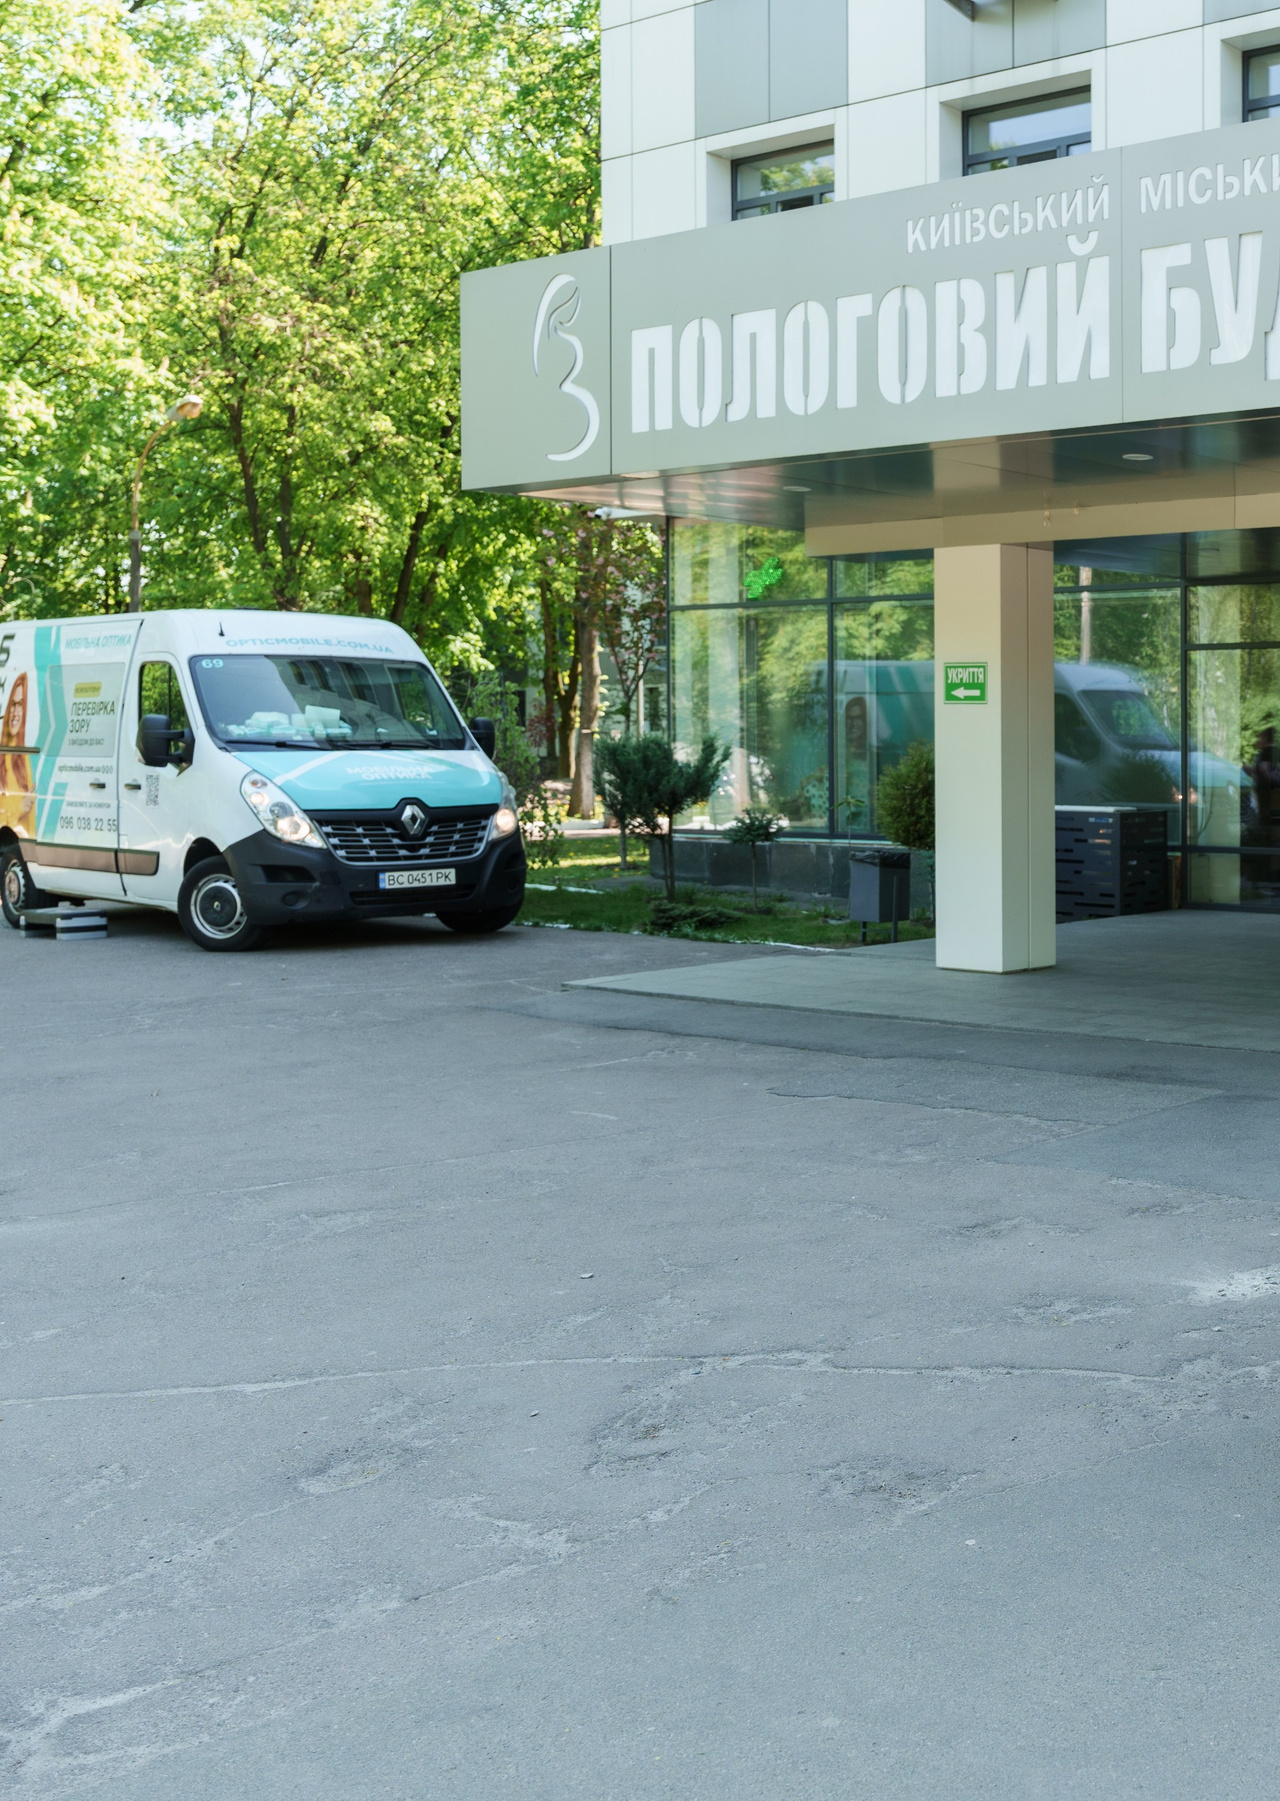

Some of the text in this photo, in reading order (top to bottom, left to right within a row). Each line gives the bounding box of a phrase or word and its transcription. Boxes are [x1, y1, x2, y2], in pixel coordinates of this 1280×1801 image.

[905, 175, 1110, 253] КИЇВСЬКИЙ
[631, 231, 1111, 433] ПОЛОГОВИЙ
[65, 634, 132, 650] МОБІЛЬНА ОПТИКА
[225, 637, 395, 654] OPTICMOBILE.COM.UA
[202, 659, 224, 669] 69
[947, 667, 985, 684] УКРИТТЯ
[71, 701, 115, 717] ПЕРЕВІРКА
[69, 718, 92, 733] ЗОРУ
[58, 763, 101, 774] opticmobile.com.ua
[60, 815, 118, 832] 096 038 22 55
[387, 870, 452, 886] BC 0451 PK
